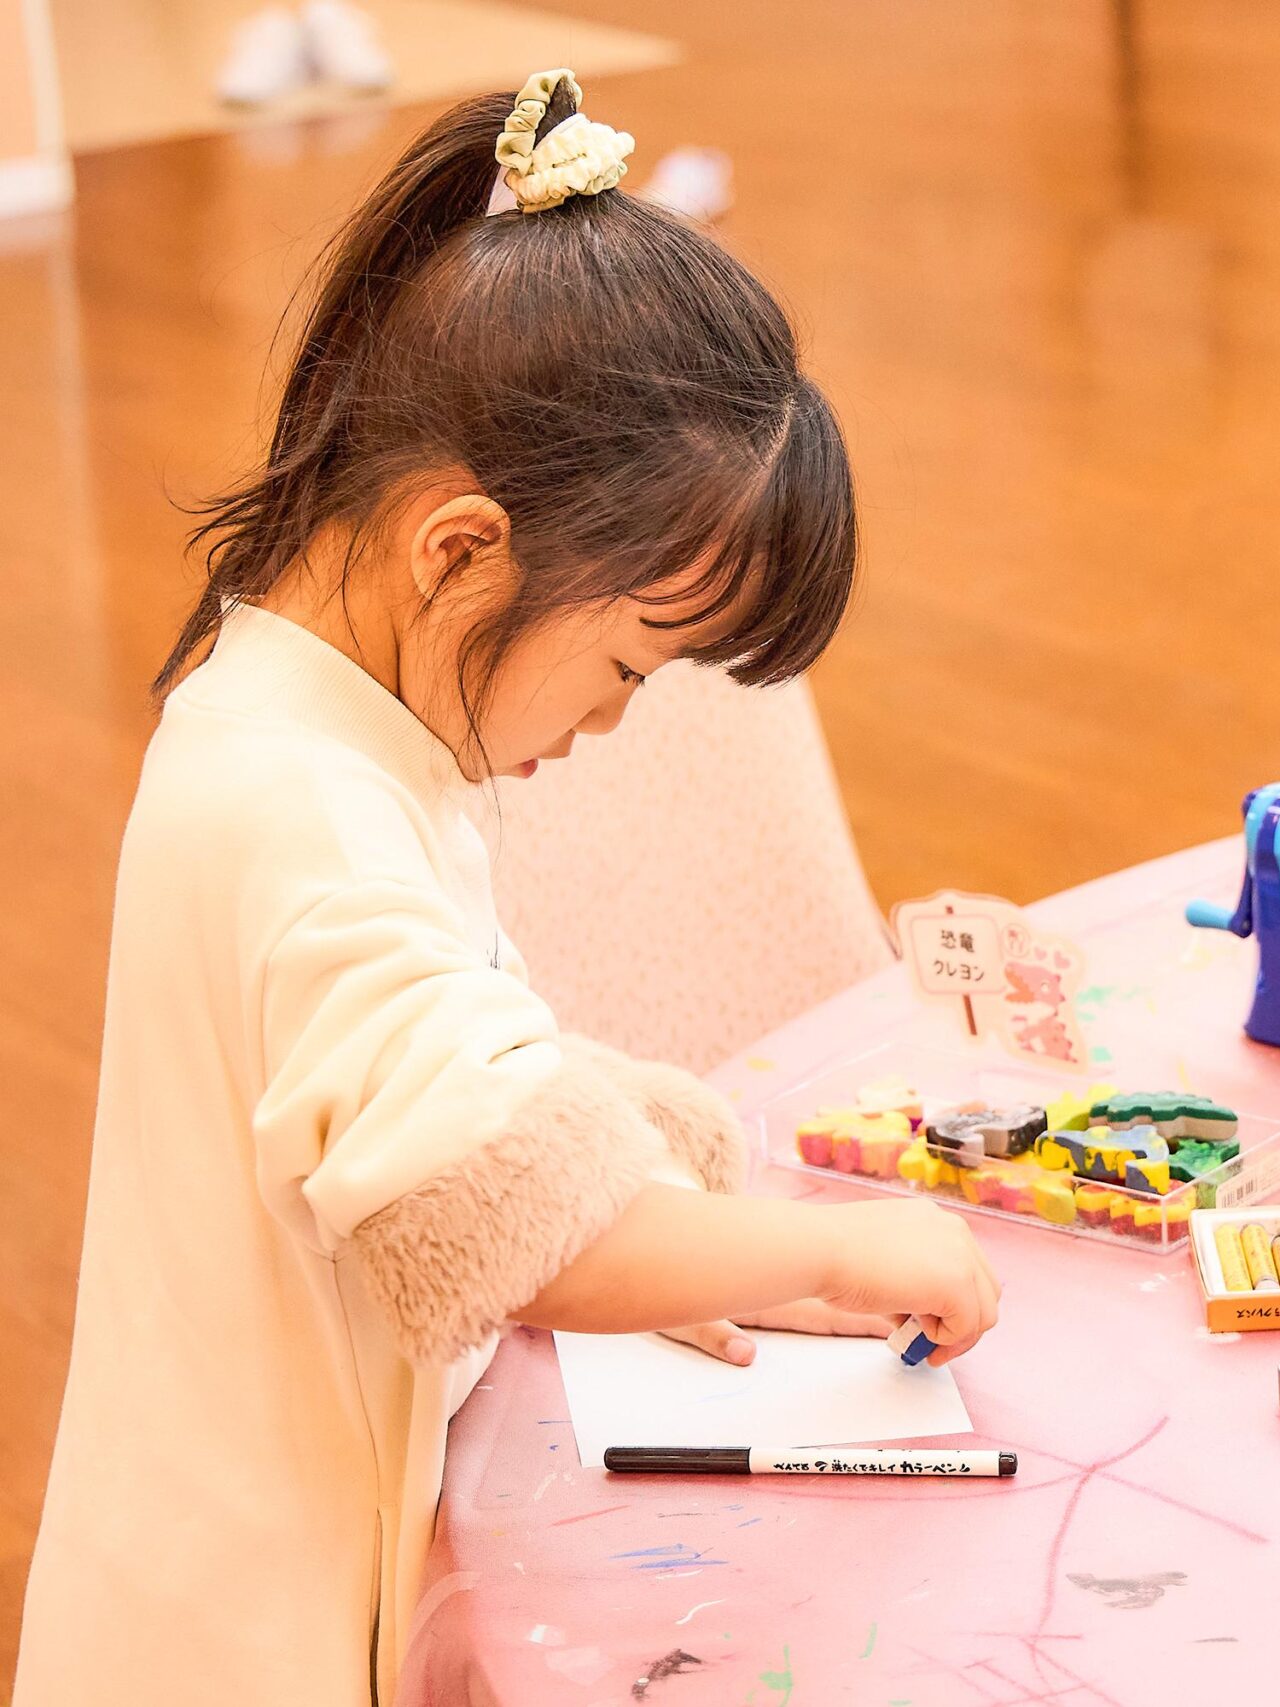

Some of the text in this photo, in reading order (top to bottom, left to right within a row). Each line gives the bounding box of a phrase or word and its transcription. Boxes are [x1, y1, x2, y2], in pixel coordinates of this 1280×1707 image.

[933, 959, 985, 982] クレヨン
[832, 1459, 896, 1473] 洗たくでキレイ
[900, 1460, 957, 1474] カラーペン
